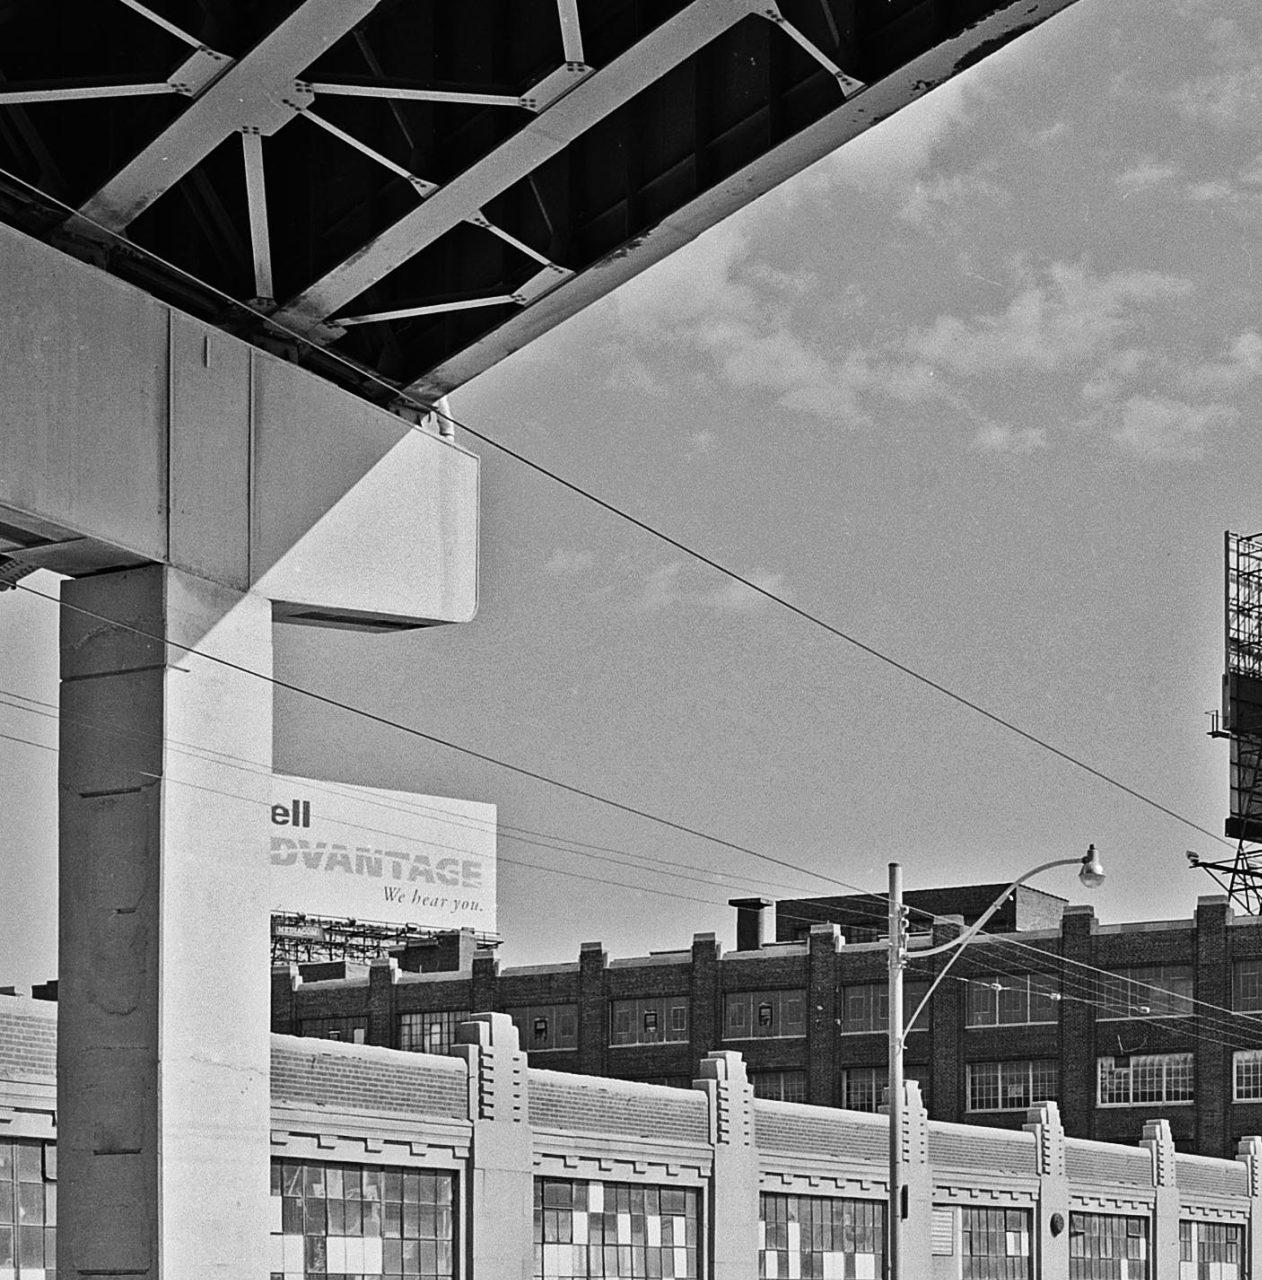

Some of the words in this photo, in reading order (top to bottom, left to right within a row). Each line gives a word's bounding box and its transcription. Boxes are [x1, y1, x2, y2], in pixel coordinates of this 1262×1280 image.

[384, 886, 405, 903] We
[411, 889, 448, 908] hear
[450, 899, 483, 914] you.
